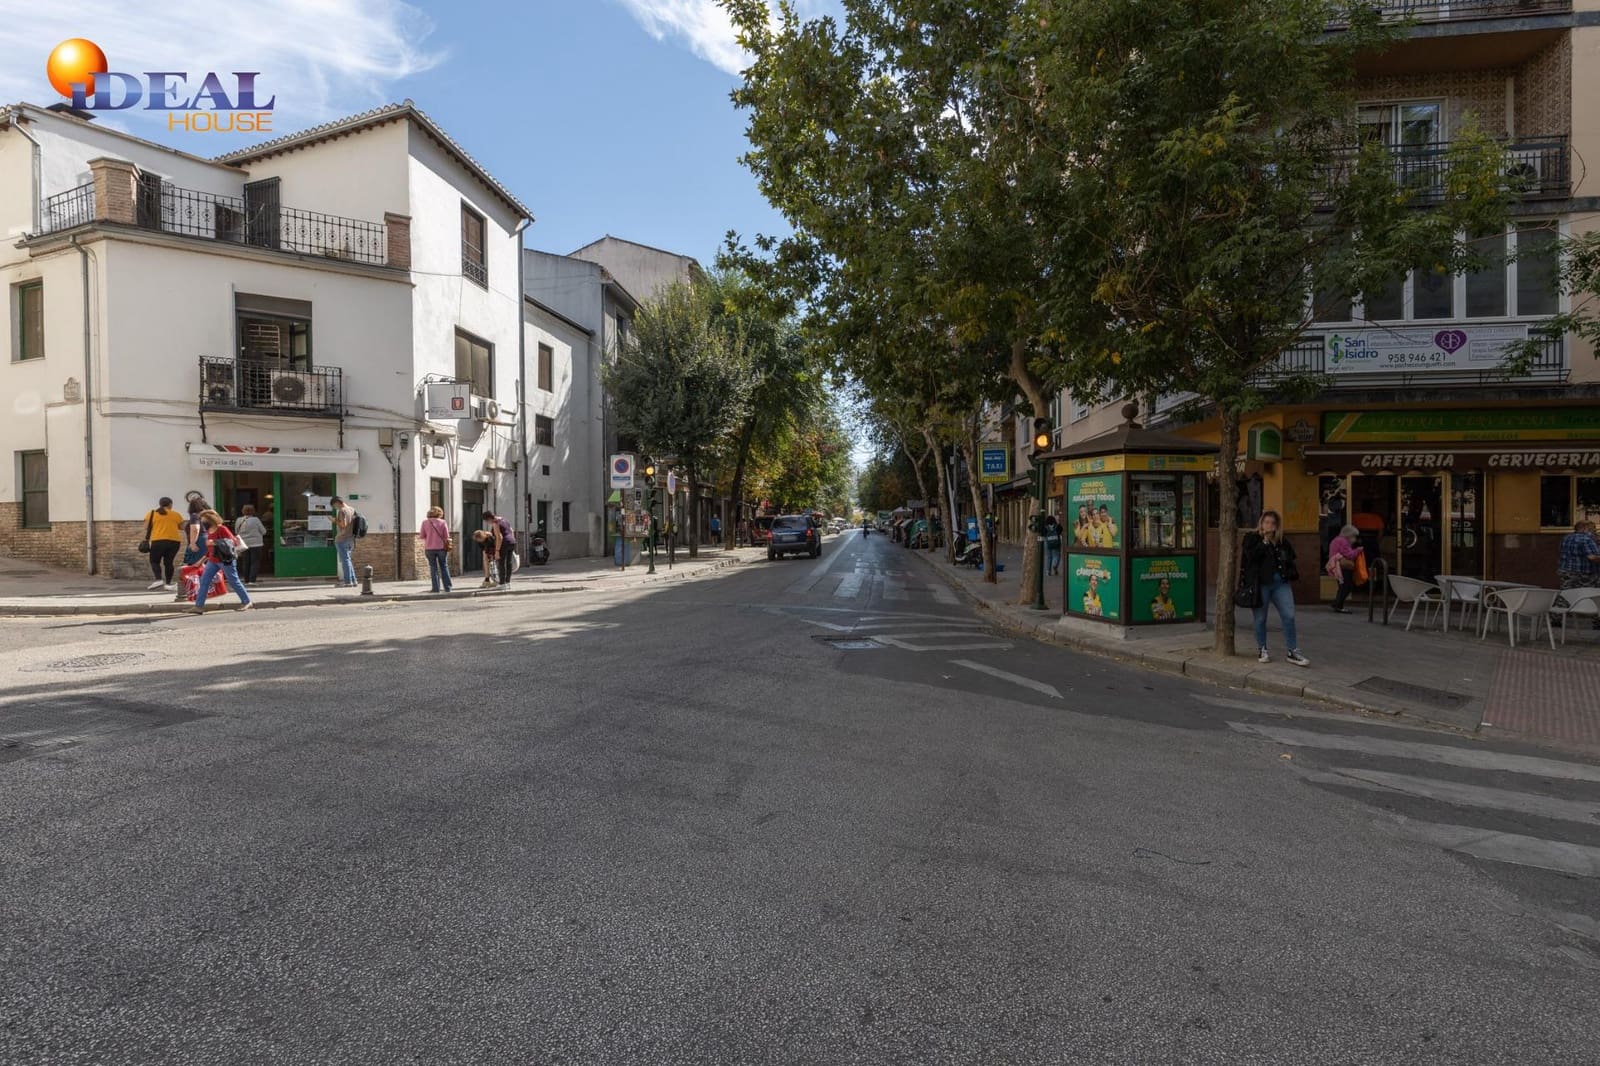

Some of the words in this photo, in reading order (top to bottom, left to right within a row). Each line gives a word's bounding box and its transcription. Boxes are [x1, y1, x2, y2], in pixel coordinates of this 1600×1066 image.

[1344, 337, 1366, 347] San
[1345, 348, 1379, 359] Isidro
[1387, 353, 1406, 363] 958
[1408, 352, 1427, 362] 946
[1429, 352, 1446, 362] 421
[206, 459, 228, 467] gracia
[1360, 454, 1455, 468] CAFETERIA
